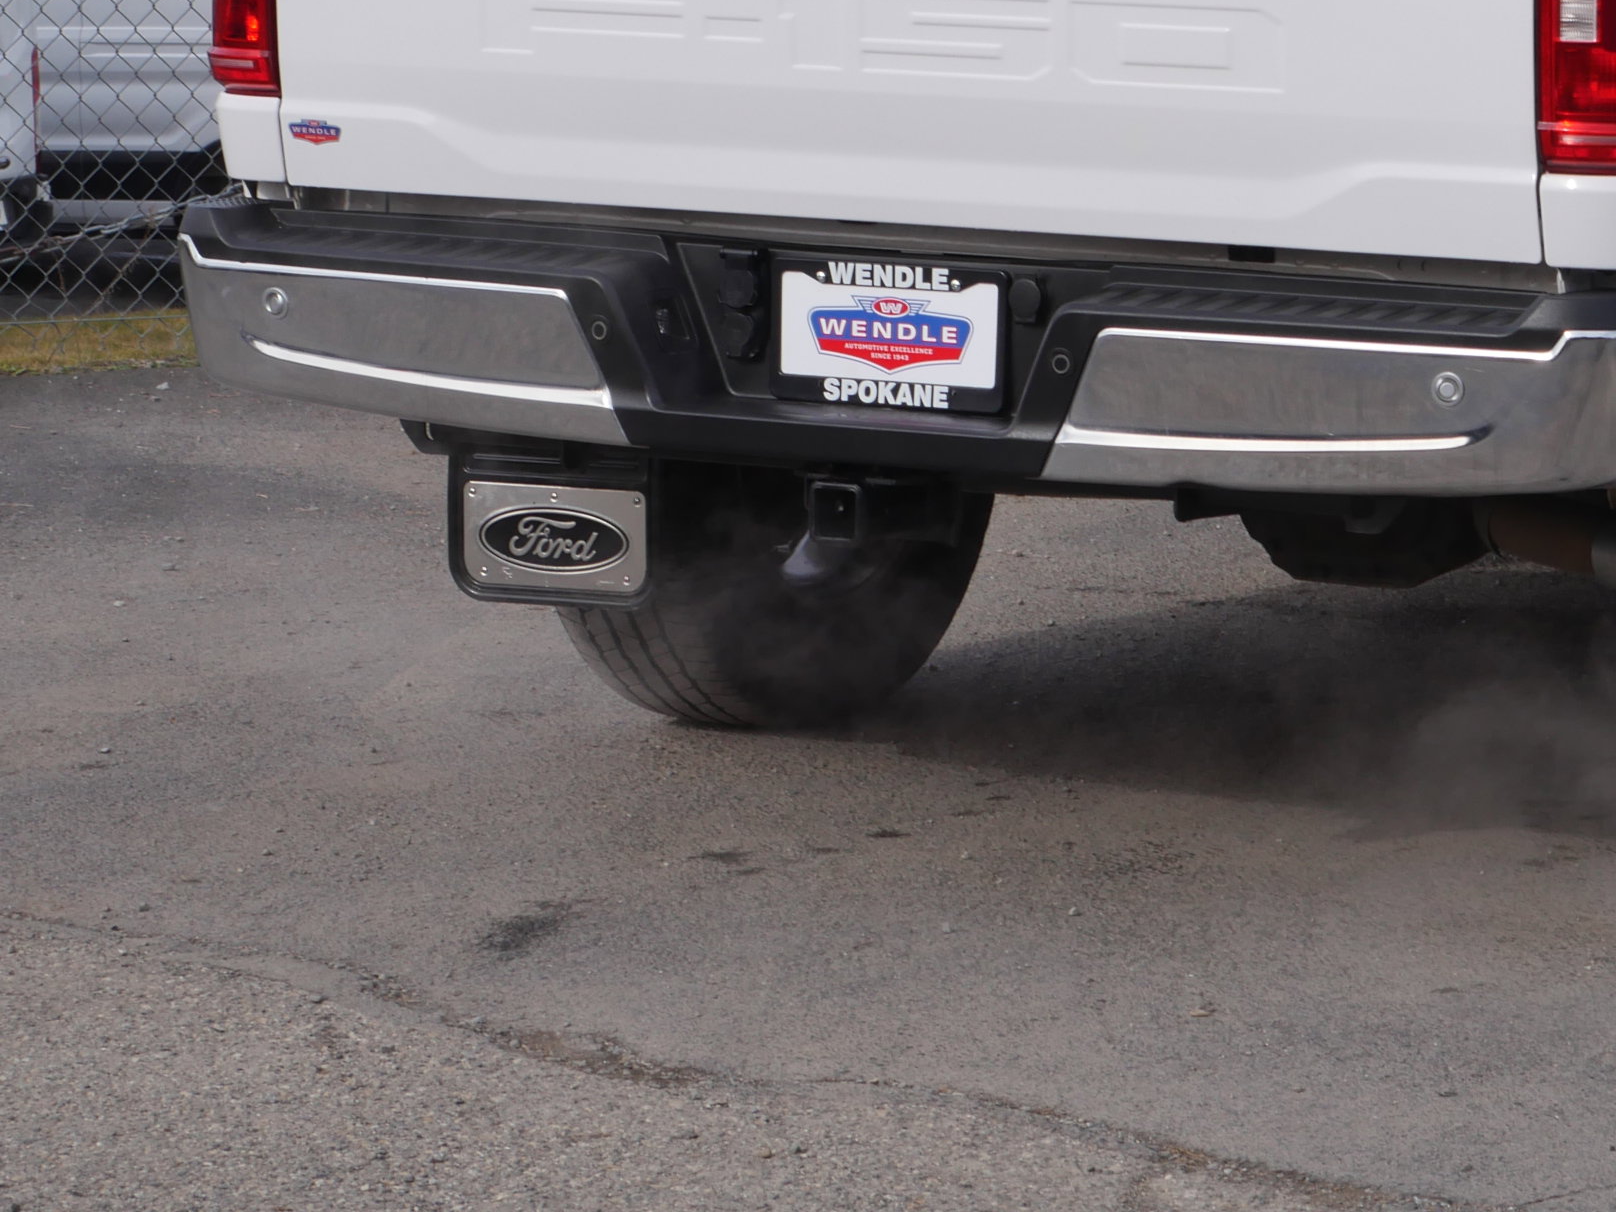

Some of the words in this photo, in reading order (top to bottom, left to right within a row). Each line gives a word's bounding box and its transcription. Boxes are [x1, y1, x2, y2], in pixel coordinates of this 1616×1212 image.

[291, 125, 337, 136] WENDLE
[827, 260, 950, 291] WENDLE
[819, 317, 958, 344] WENDLE
[844, 342, 889, 352] AUTOMOTIVE
[890, 345, 934, 355] EXCELLENCE
[870, 352, 892, 360] SINCE
[823, 377, 950, 409] SPOKANE
[508, 516, 600, 562] Ford
